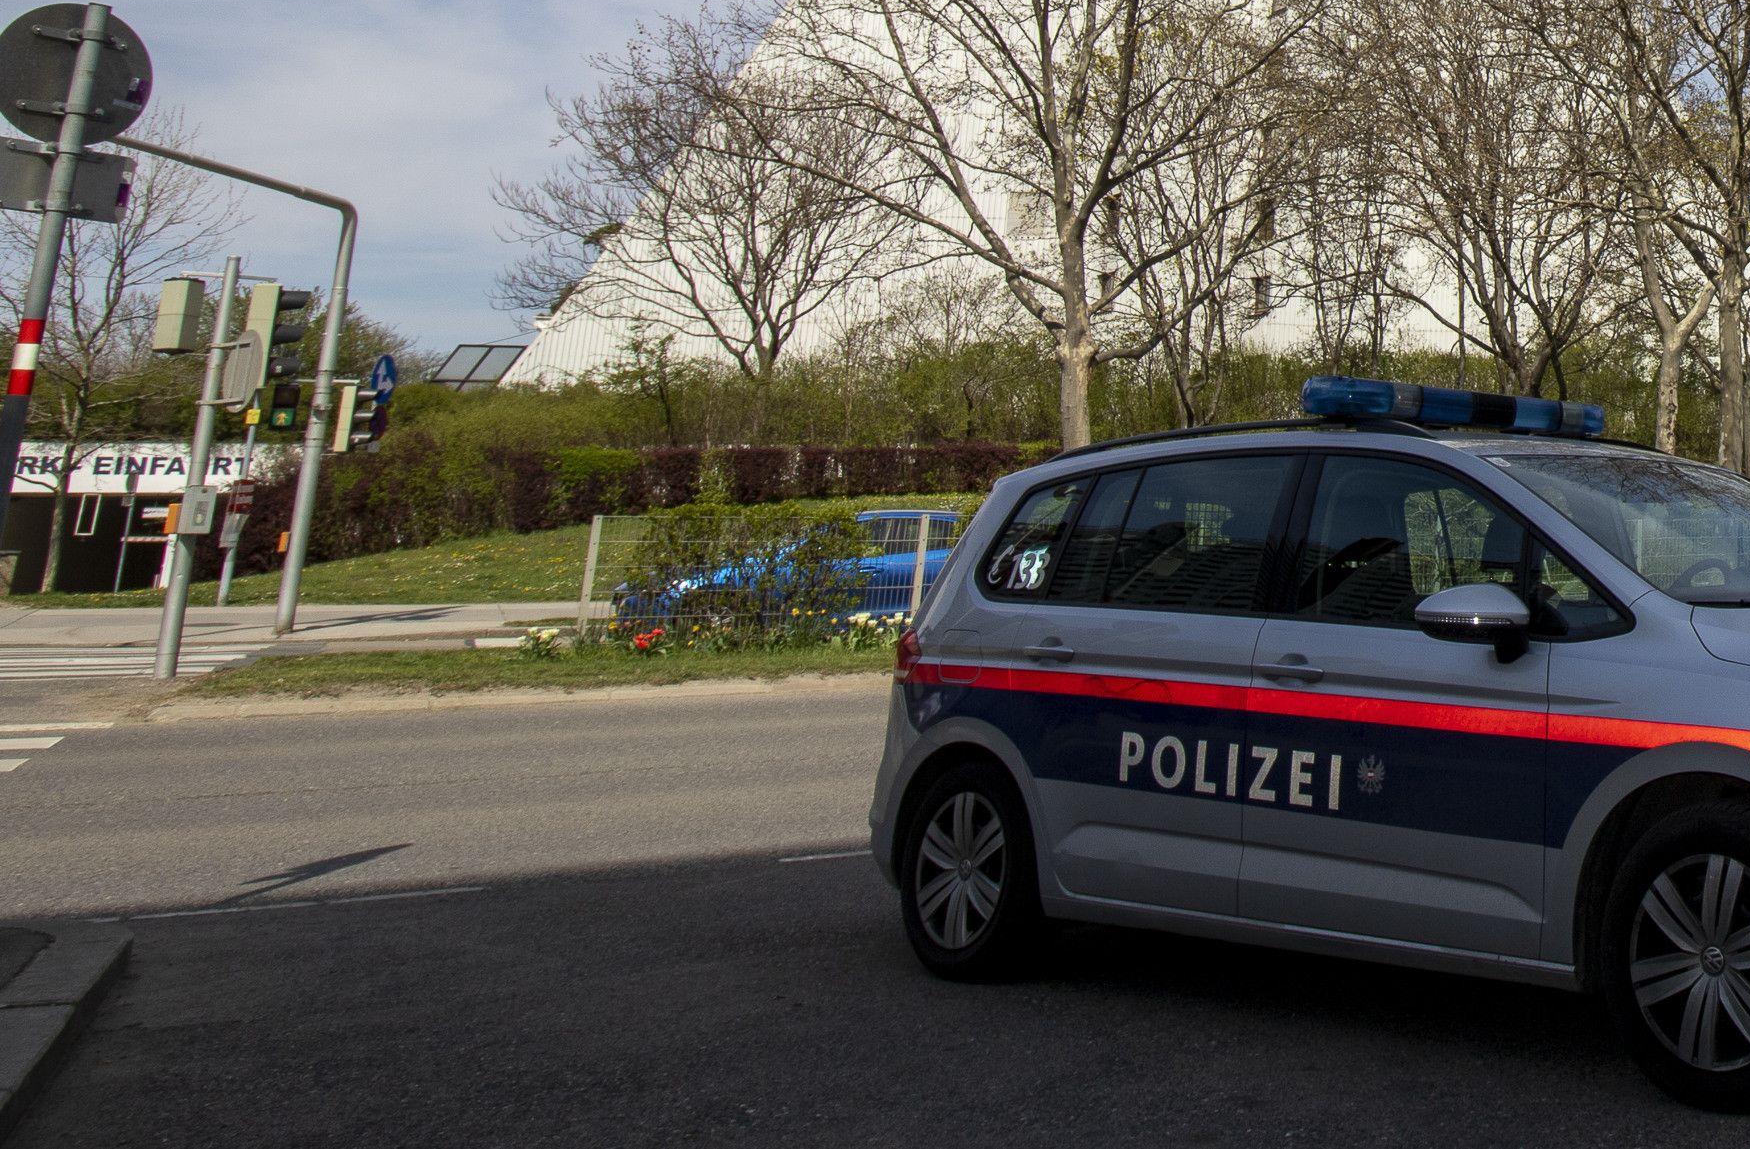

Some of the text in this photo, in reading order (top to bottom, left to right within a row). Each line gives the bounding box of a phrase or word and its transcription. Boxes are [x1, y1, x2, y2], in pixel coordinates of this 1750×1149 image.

[92, 456, 254, 476] EINFART
[1006, 553, 1050, 590] 133
[1119, 731, 1342, 811] POLIZEI
